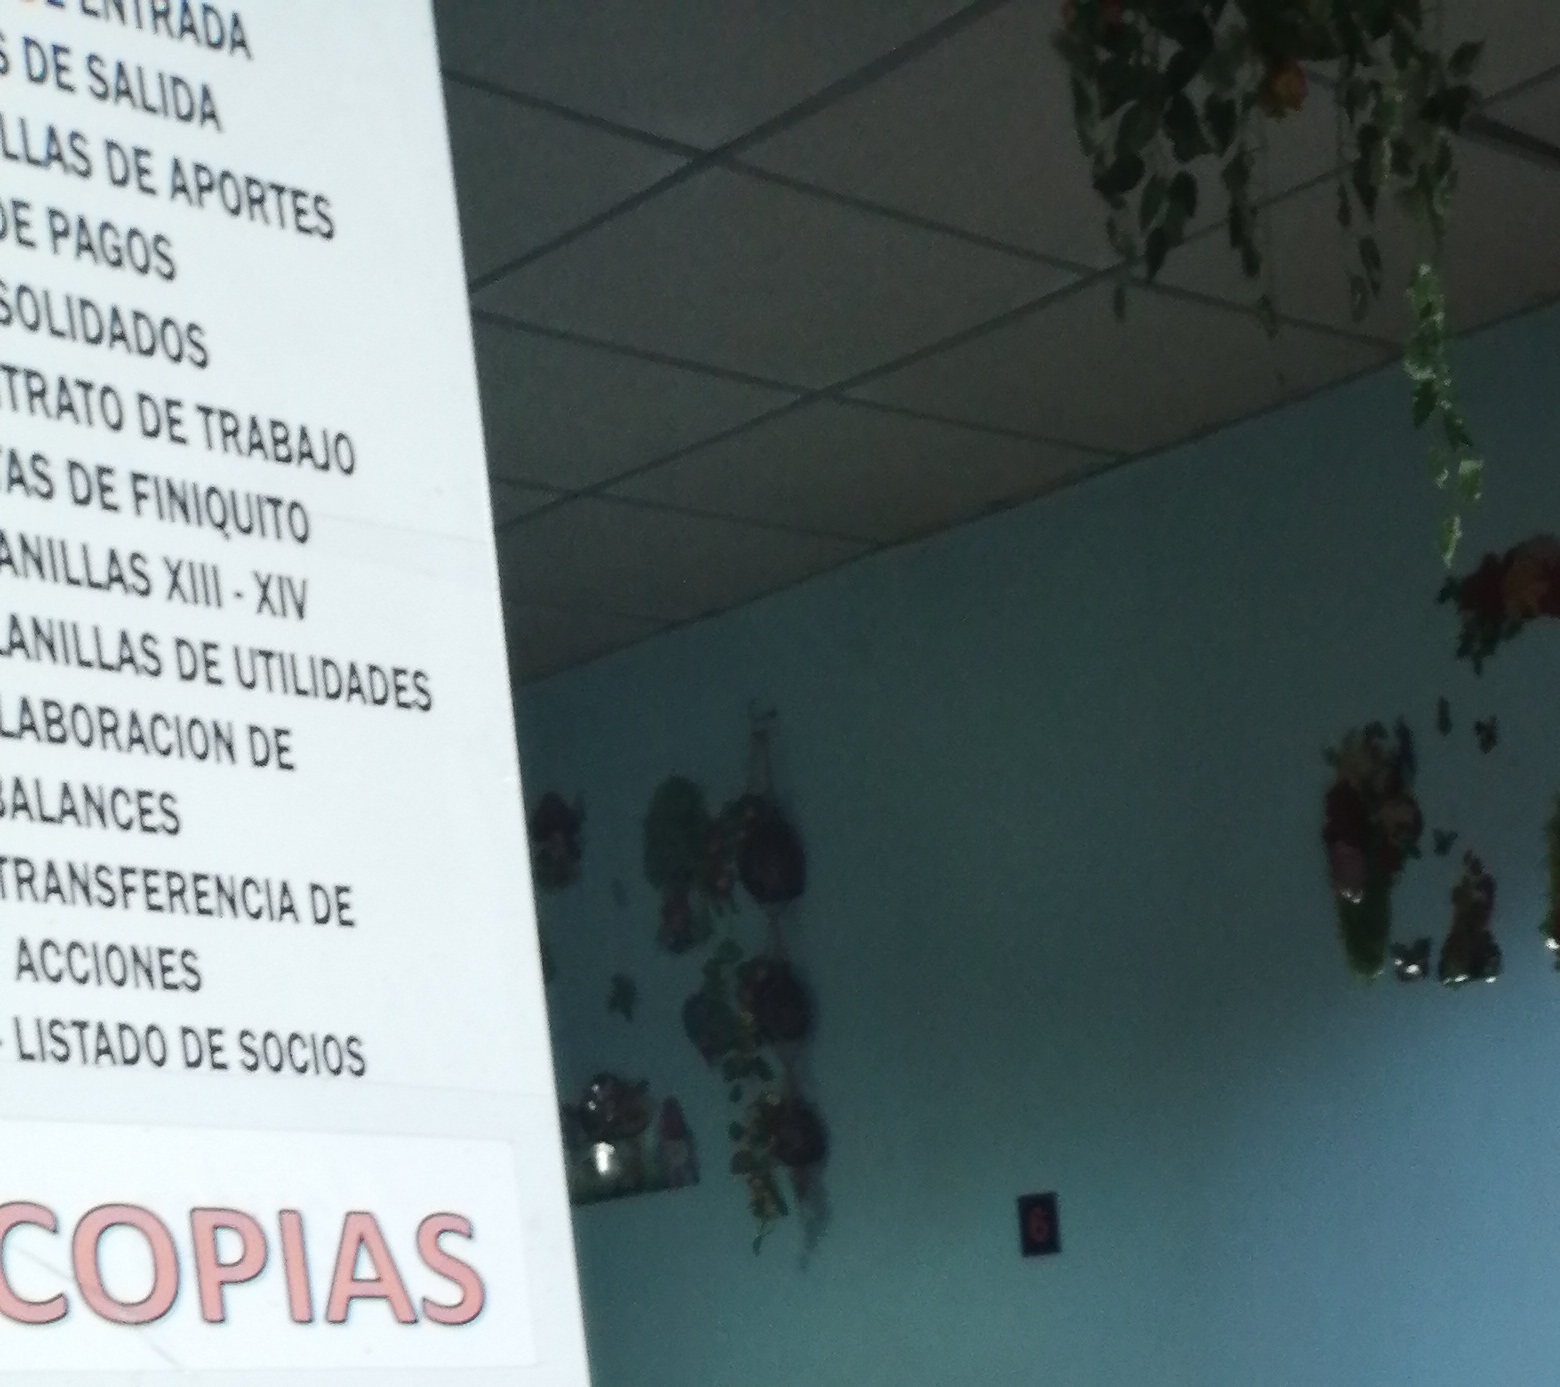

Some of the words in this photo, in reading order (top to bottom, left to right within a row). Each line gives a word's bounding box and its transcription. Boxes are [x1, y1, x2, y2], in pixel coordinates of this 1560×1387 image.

[22, 36, 76, 94] DE
[86, 52, 224, 132] SALIDA
[105, 138, 158, 196] DE
[169, 155, 336, 241] APORTES
[0, 197, 35, 249] E
[48, 207, 177, 282] PAGOS
[0, 362, 124, 433] TRATO
[138, 392, 188, 446] DE
[196, 403, 356, 477] TRABAJO
[67, 459, 119, 512] DE
[131, 472, 310, 546] FINIQUITO
[163, 556, 222, 608] XIII
[252, 570, 309, 621] XIV
[175, 635, 224, 686] DE
[234, 646, 433, 712] UTILIDADES
[249, 723, 295, 771] DE
[0, 777, 181, 836] ALANCES
[311, 882, 356, 928] DE
[15, 937, 202, 993] ACCIONES
[13, 1016, 167, 1069] LISTADO
[182, 1026, 228, 1071] DE
[239, 1028, 367, 1077] SOCIOS
[0, 1200, 486, 1326] COPIAS
